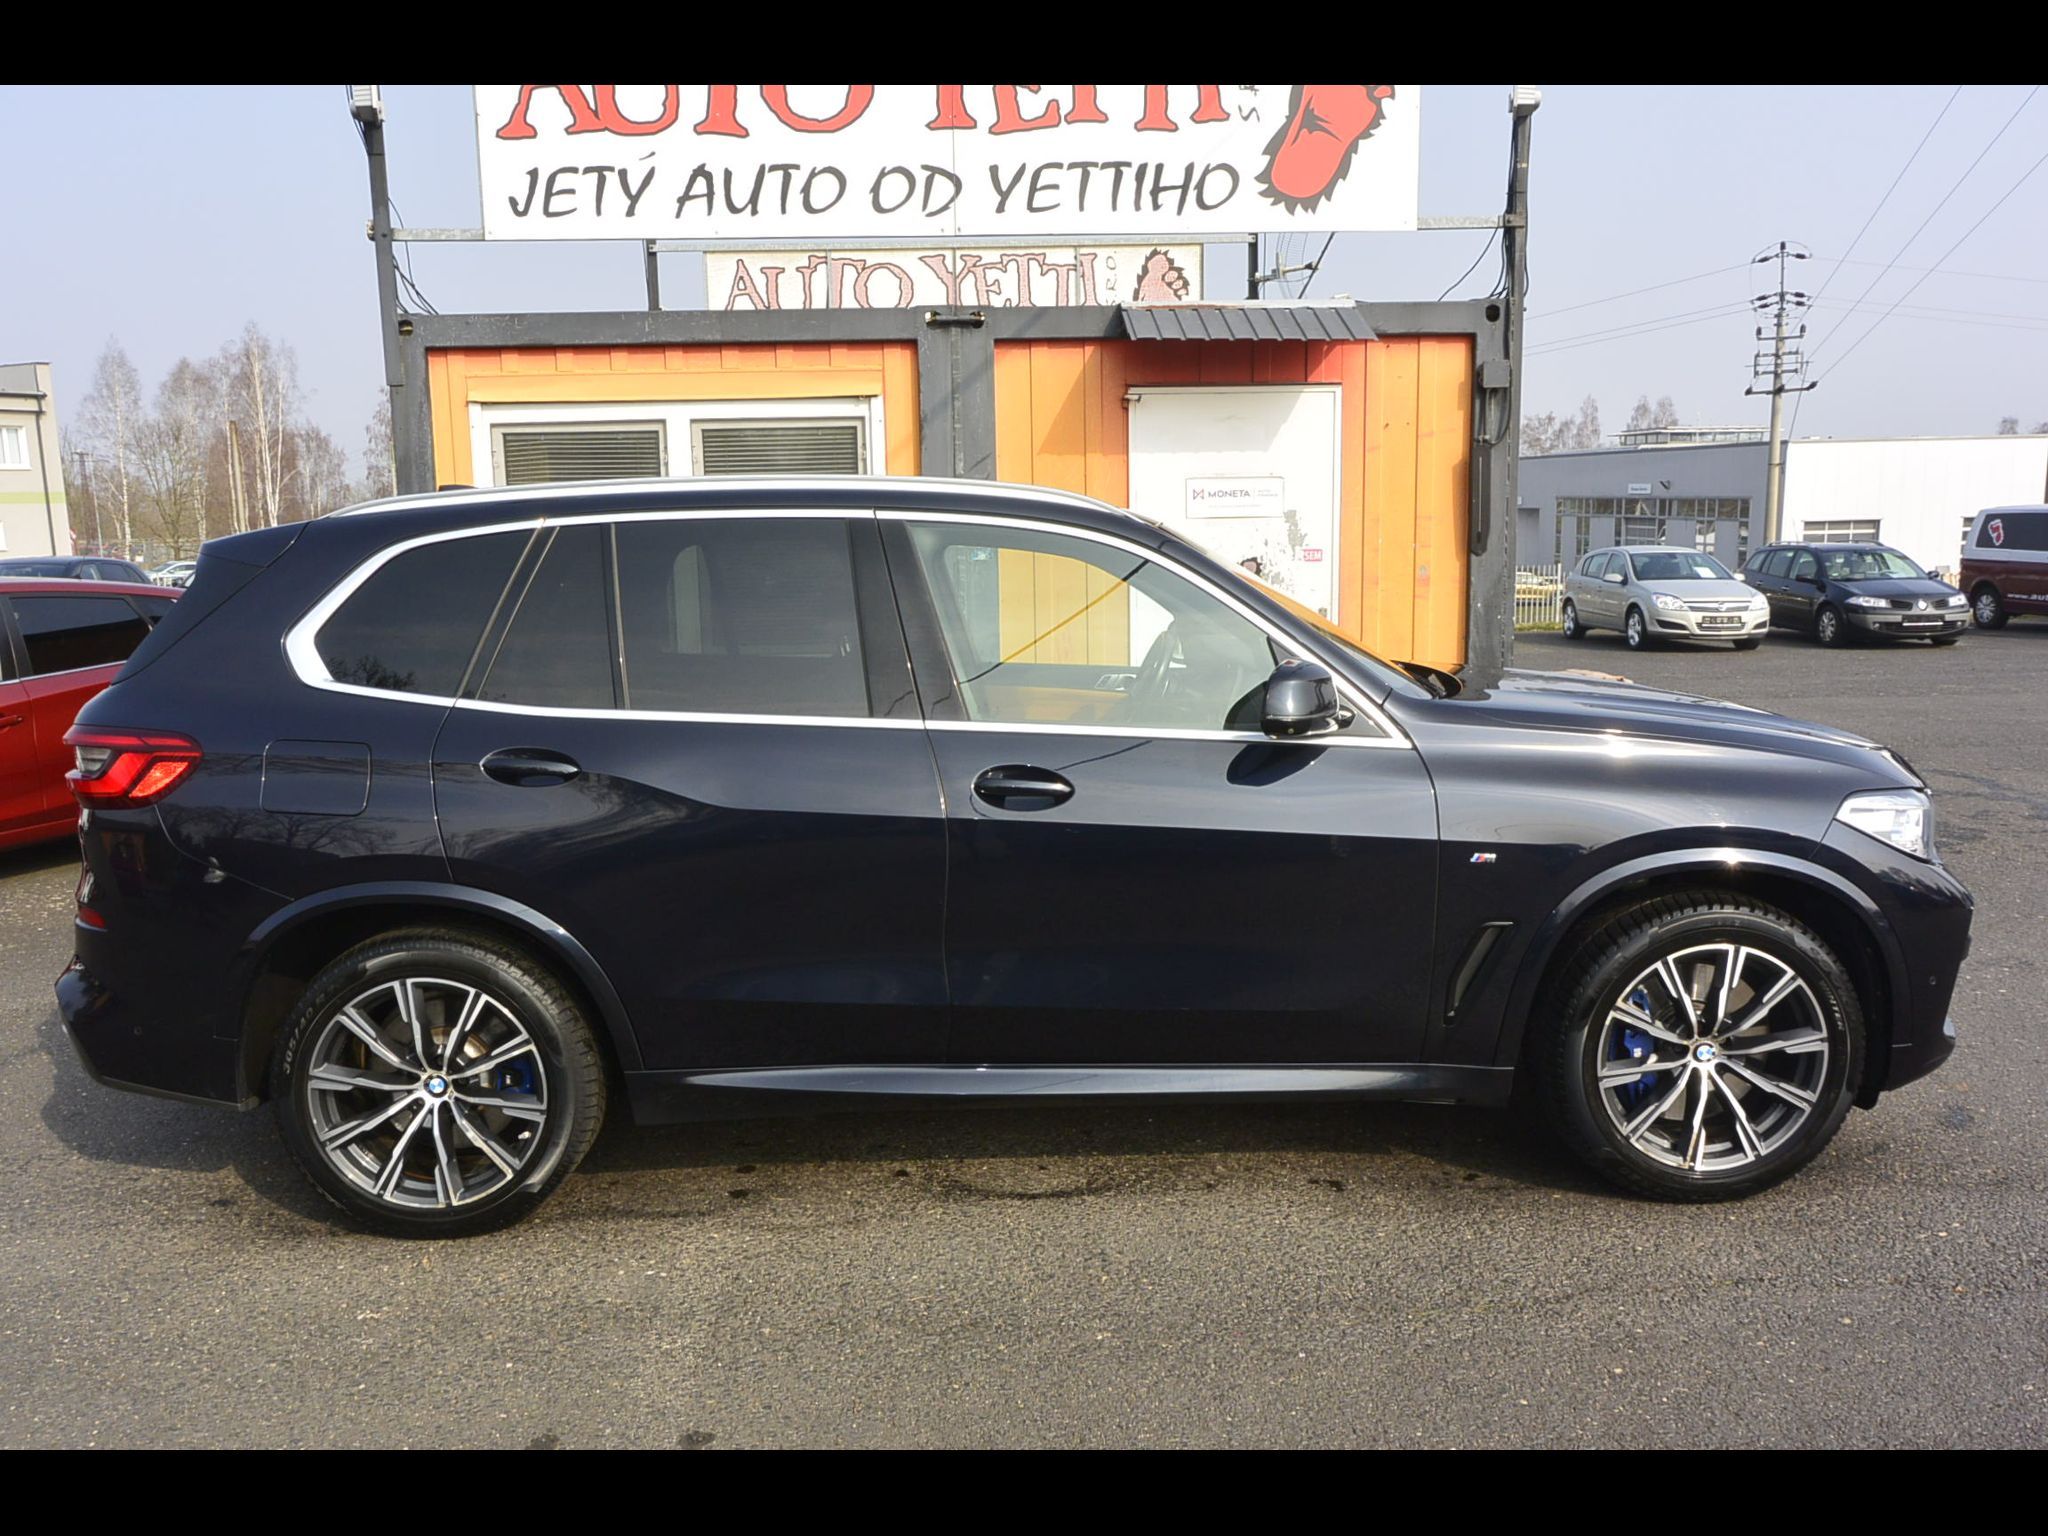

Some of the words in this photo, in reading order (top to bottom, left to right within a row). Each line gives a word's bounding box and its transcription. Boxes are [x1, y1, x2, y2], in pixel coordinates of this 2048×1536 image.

[509, 151, 656, 218] JETÝ
[675, 163, 847, 219] AUTO
[868, 163, 963, 218] OD
[988, 161, 1241, 216] YETTIHO
[724, 254, 914, 311] AUTO
[918, 252, 1101, 308] YETTI
[1207, 489, 1252, 499] MONETA
[1304, 550, 1322, 561] SEM
